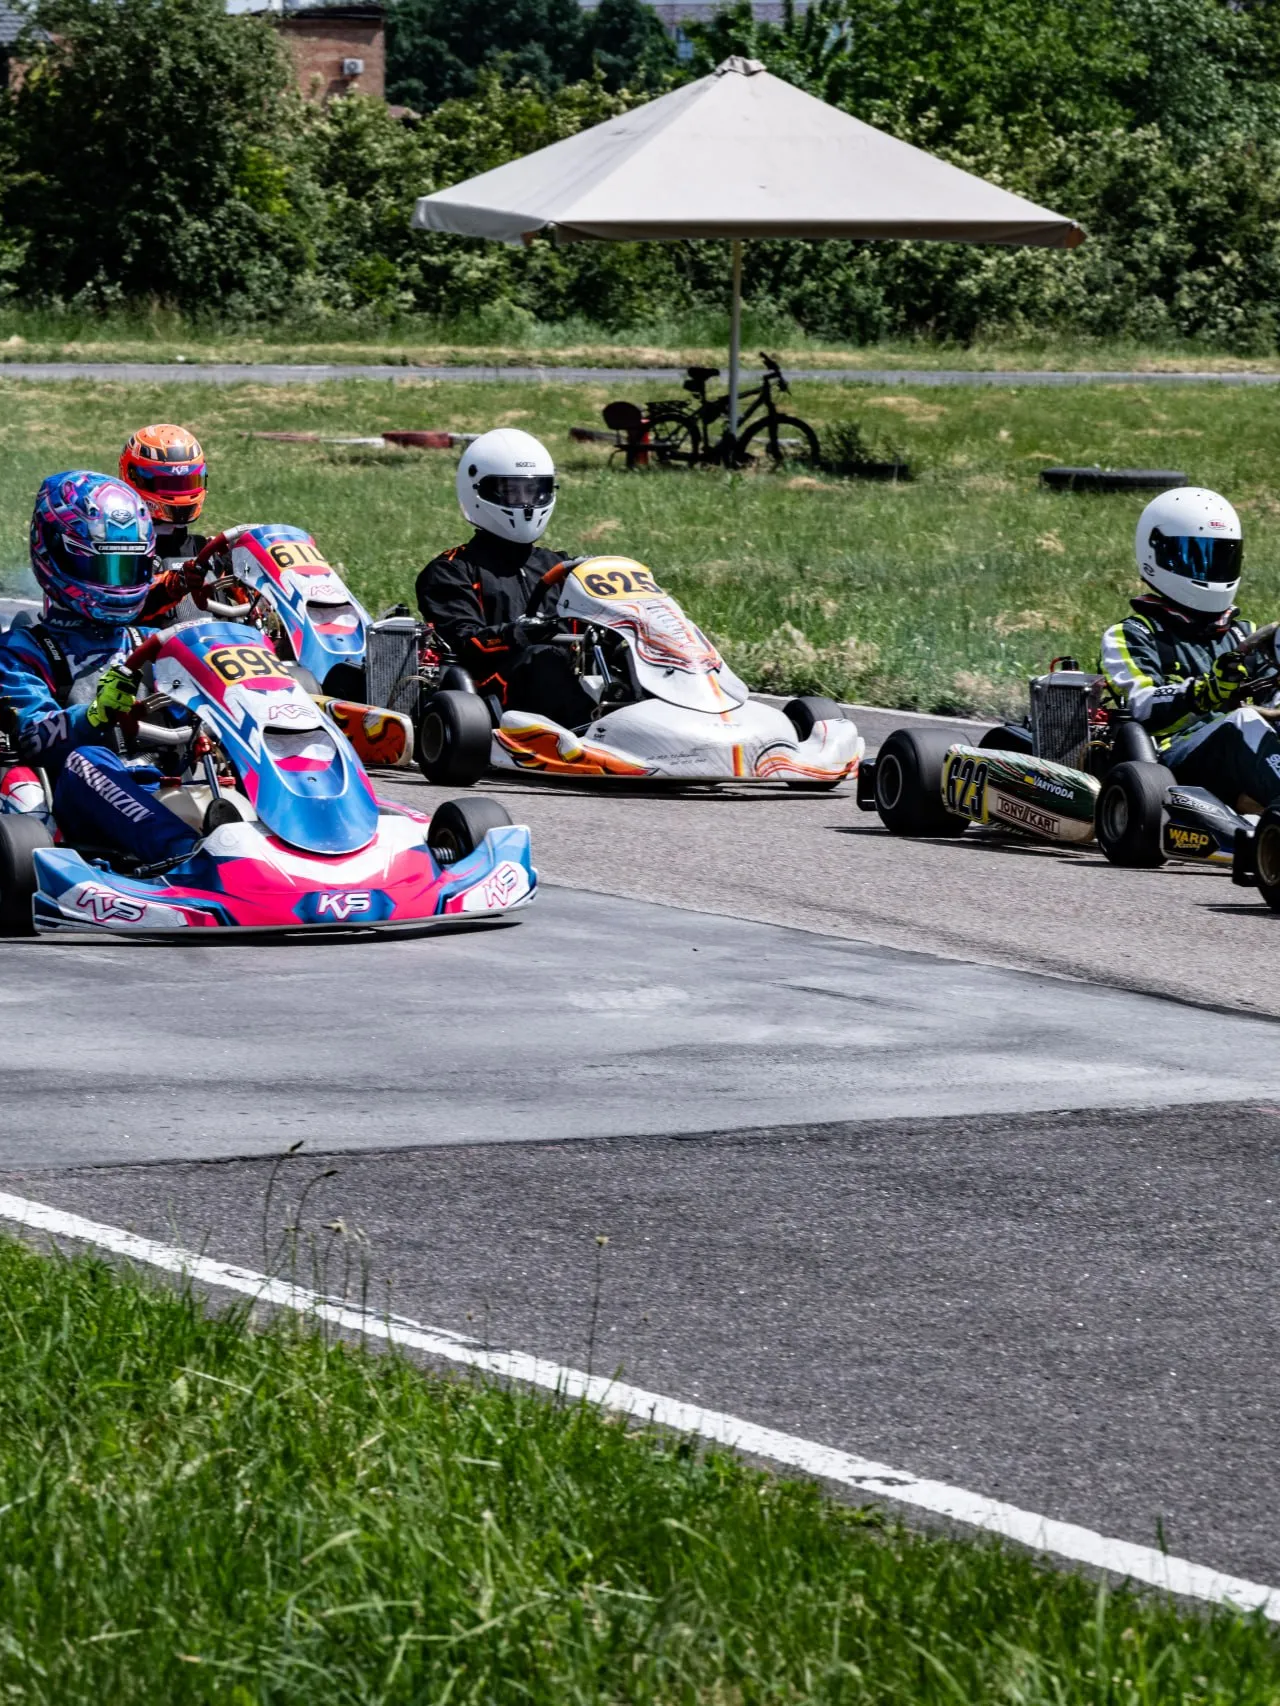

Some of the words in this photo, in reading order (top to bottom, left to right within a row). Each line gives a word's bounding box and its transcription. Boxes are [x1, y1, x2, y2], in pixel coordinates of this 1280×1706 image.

[584, 570, 663, 596] 625
[947, 754, 989, 820] 623
[1033, 775, 1075, 801] VARYVODA
[1169, 828, 1210, 846] WARD
[77, 887, 148, 923] KS
[317, 892, 371, 922] KS
